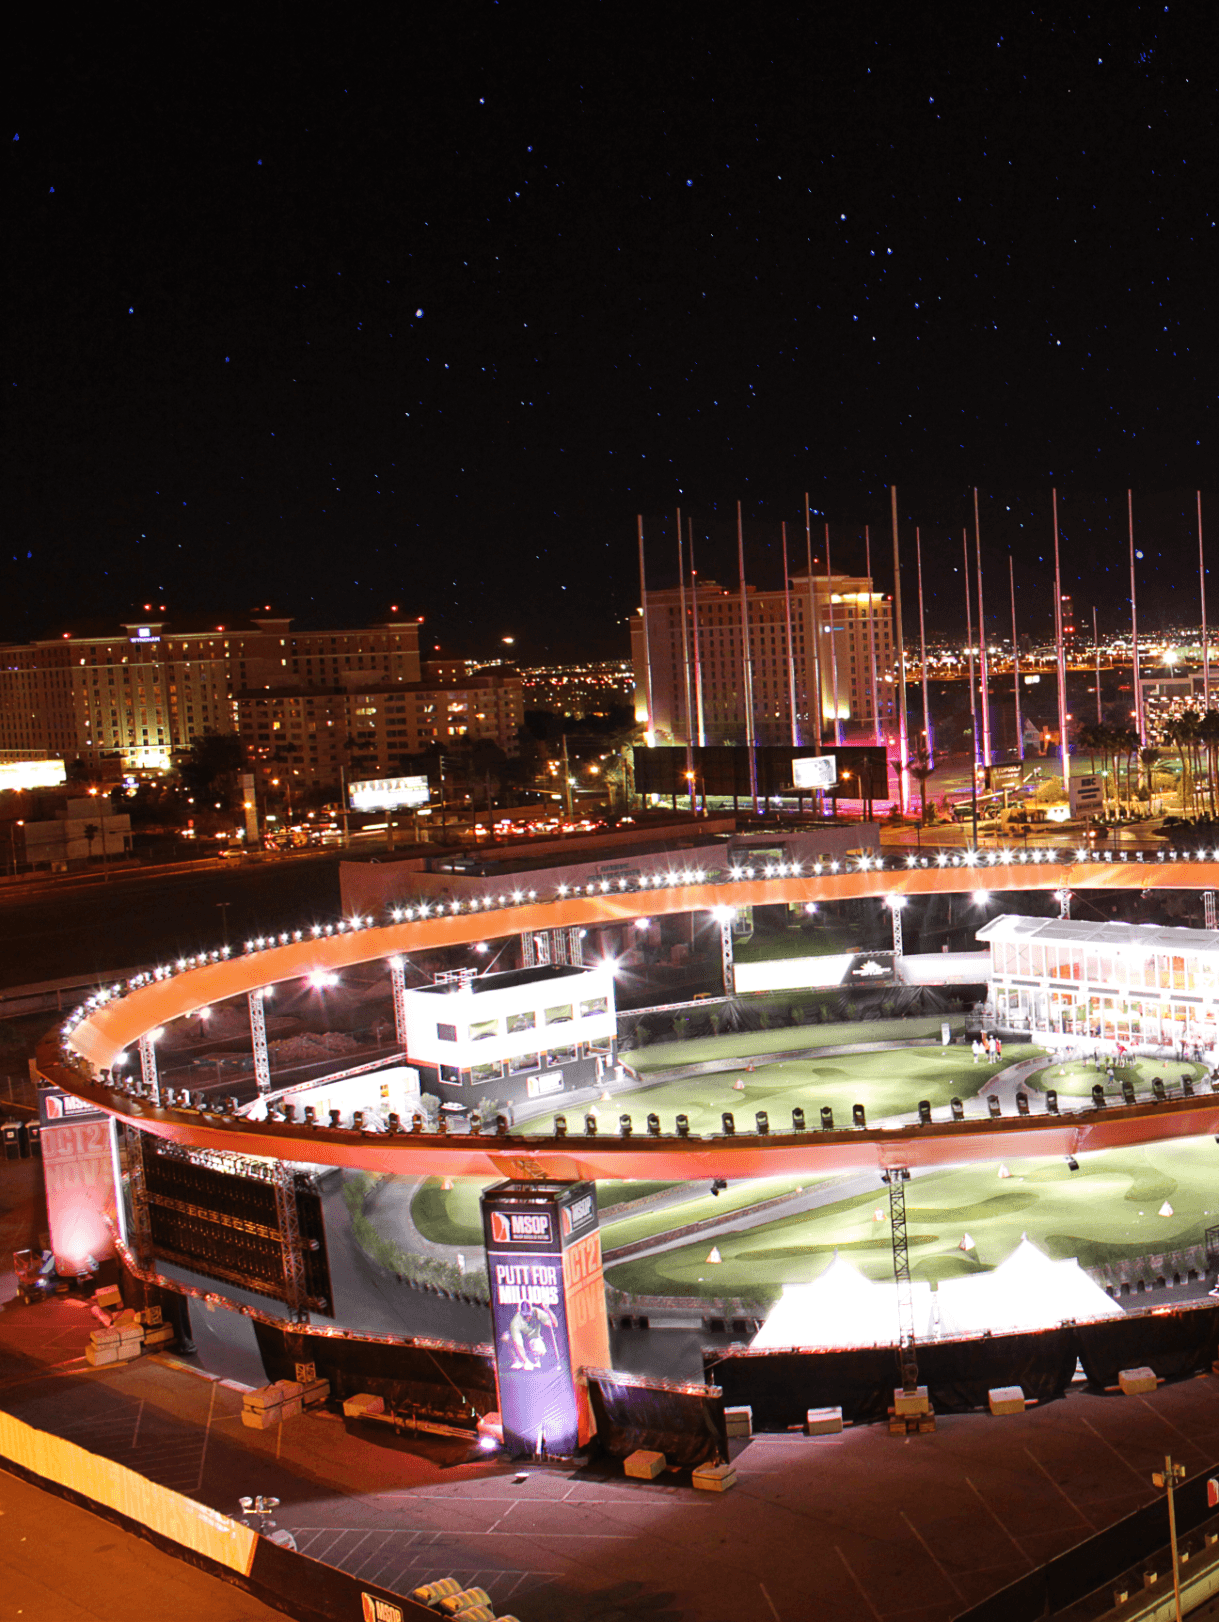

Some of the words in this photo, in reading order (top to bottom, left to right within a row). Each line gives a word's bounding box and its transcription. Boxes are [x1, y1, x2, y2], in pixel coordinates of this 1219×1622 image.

[511, 1216, 548, 1234] MSOP
[496, 1265, 529, 1285] PUTT
[532, 1266, 557, 1285] FOR
[499, 1285, 558, 1305] MILLIONS
